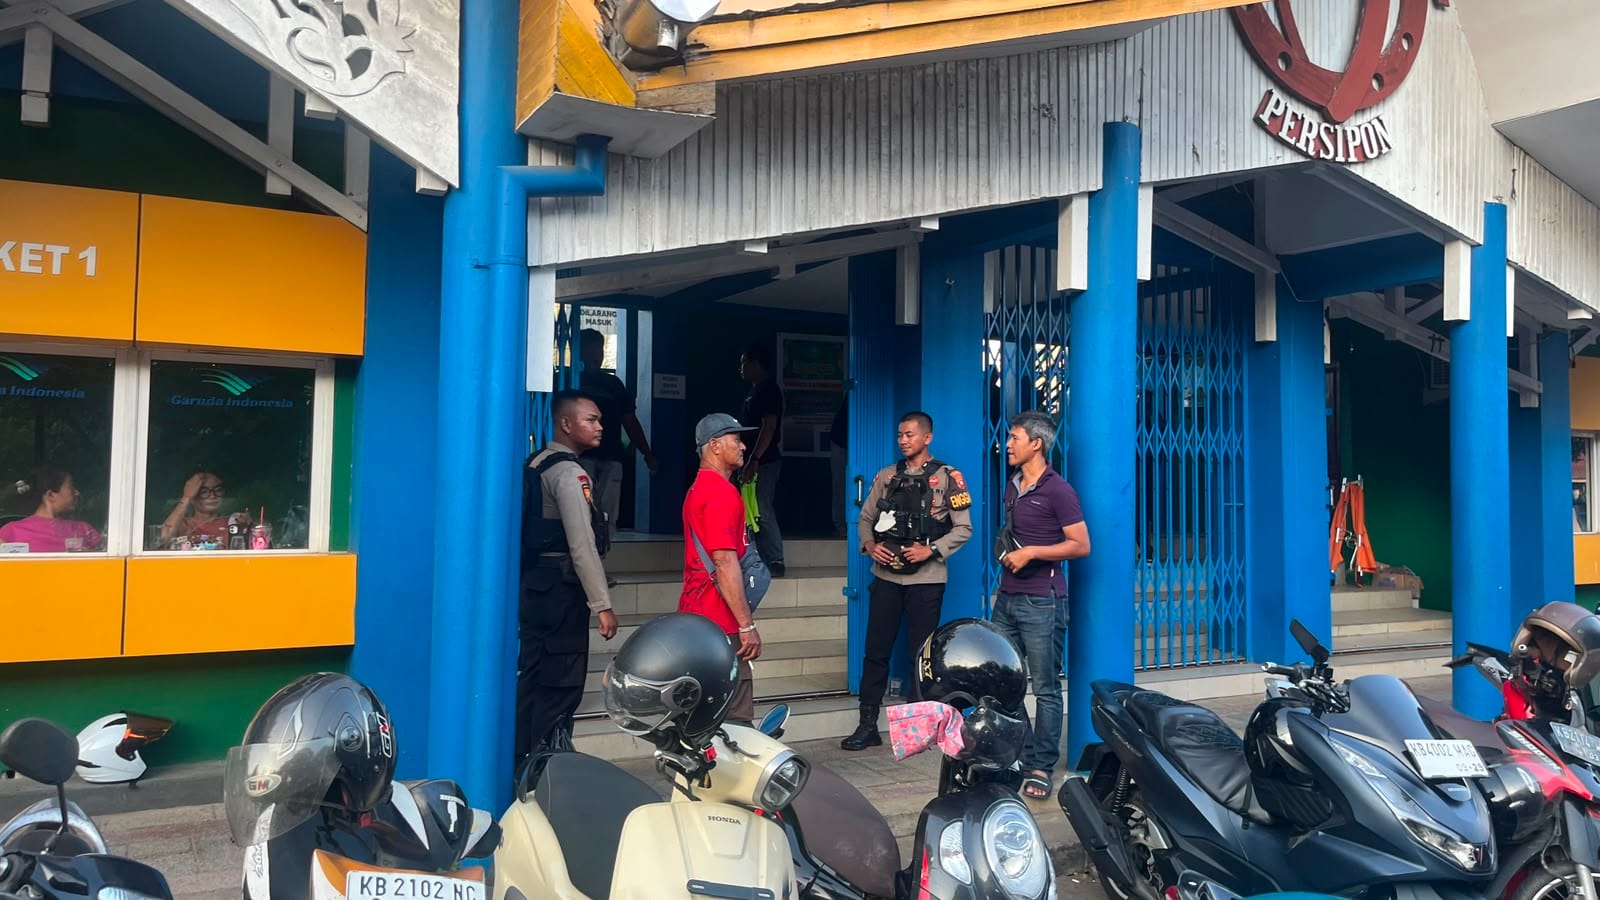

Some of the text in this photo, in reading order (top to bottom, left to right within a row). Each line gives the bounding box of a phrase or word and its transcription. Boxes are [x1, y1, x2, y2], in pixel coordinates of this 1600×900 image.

[1259, 88, 1393, 162] PERSIPON
[79, 246, 97, 276] 1
[586, 318, 612, 326] MASUK
[10, 386, 86, 398] Indonesia
[170, 395, 293, 408] Garuda Indonesia
[708, 815, 741, 825] HONDA
[360, 876, 386, 897] KB
[394, 878, 443, 899] 2102
